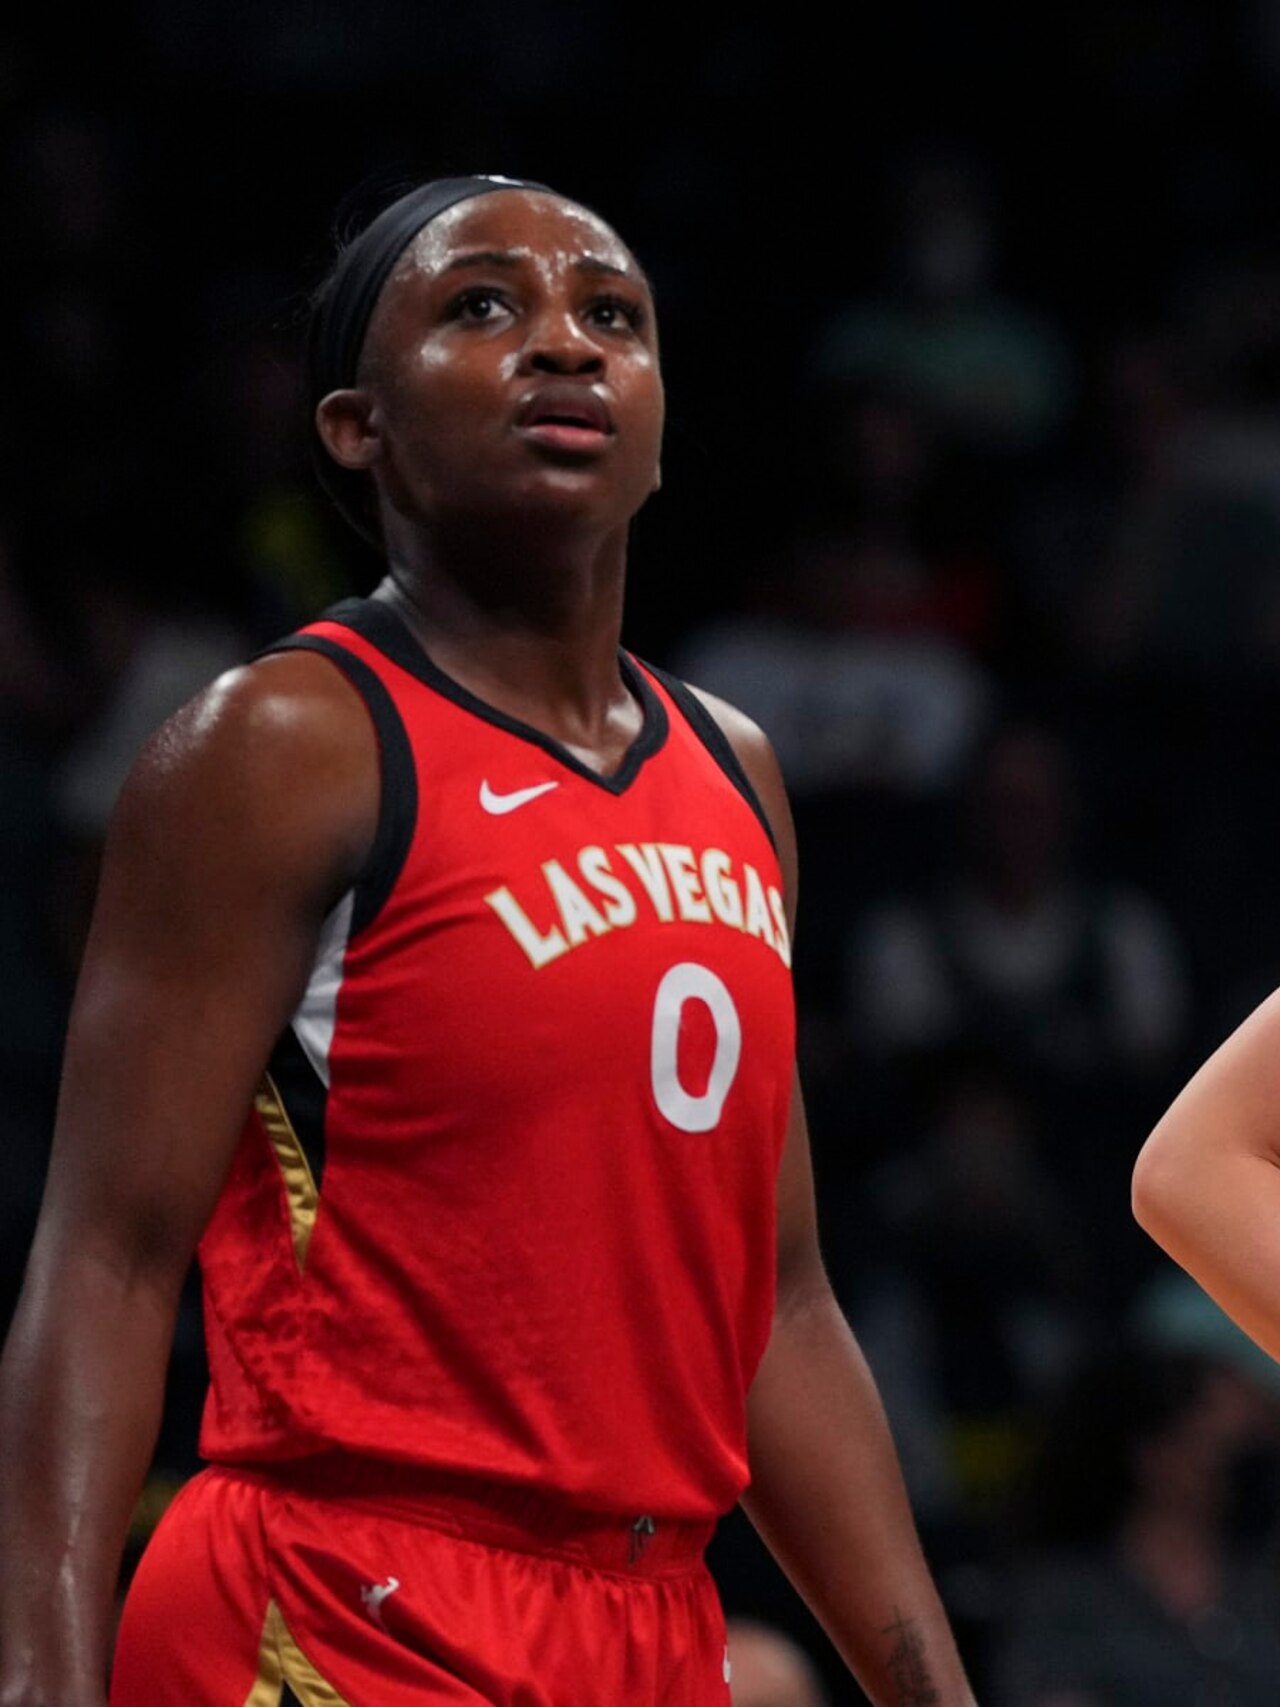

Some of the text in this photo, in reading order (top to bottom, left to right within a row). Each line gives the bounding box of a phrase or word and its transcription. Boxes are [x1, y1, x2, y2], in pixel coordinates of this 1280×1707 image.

[484, 842, 793, 971] LAS VEGAS
[651, 961, 742, 1133] 0
